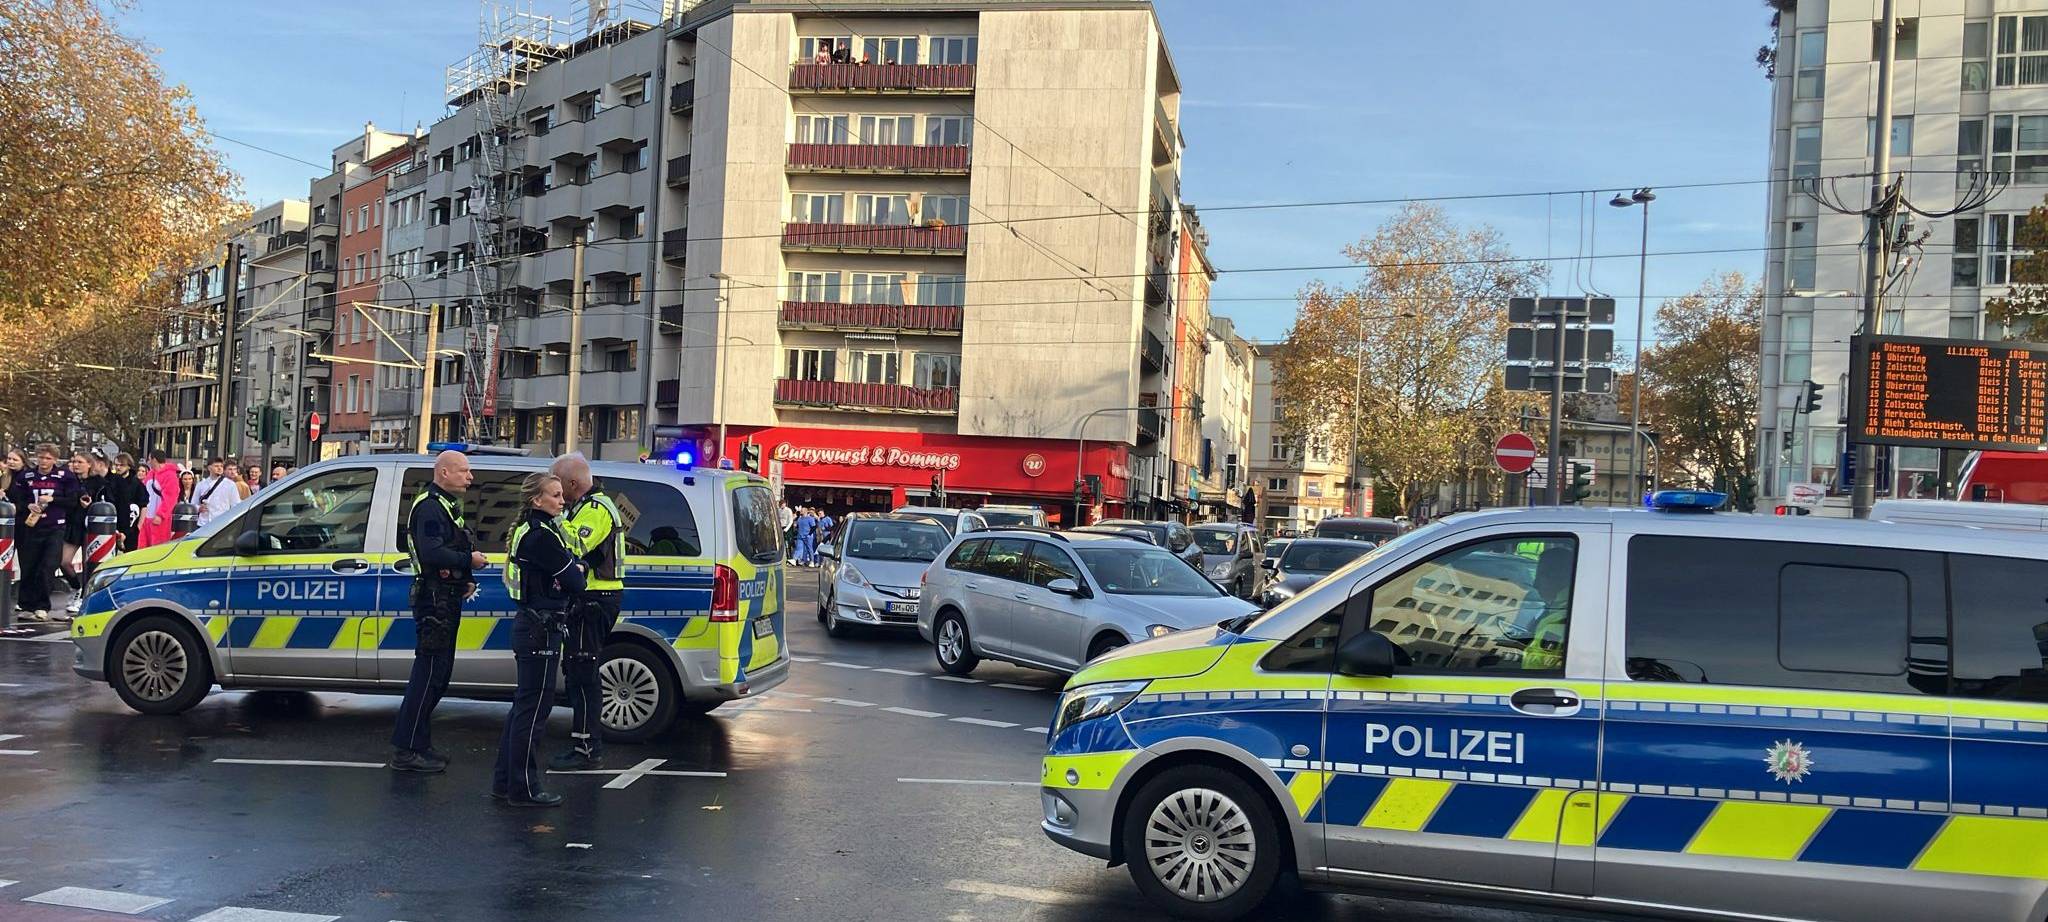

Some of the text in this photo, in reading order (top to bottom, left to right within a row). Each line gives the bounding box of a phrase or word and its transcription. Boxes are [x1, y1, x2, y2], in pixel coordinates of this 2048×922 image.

[1884, 343, 1920, 354] Dienstag
[1946, 346, 1988, 356] 11.11.2025
[1872, 352, 1880, 360] 16
[1980, 358, 2001, 366] Gleis
[2020, 360, 2046, 370] Sofort
[1872, 362, 1880, 370] 12
[1887, 362, 1926, 372] Zollstock
[1980, 368, 2000, 376] Gleis
[2018, 370, 2046, 378] Sofort
[1871, 371, 1880, 379] 12
[1886, 372, 1928, 382] Merkenich
[1980, 377, 2000, 386] Gleis
[2032, 380, 2045, 388] Min
[1870, 380, 1880, 388] 15
[1979, 386, 2000, 394] Gleis
[2031, 390, 2045, 398] Min
[1870, 390, 1879, 398] 15
[1886, 391, 1930, 400] Chorweiler
[1978, 396, 1999, 404] Gleis
[2031, 398, 2044, 406] Min
[1869, 399, 1878, 407] 12
[1885, 400, 1924, 410] Zollstock
[1978, 405, 1998, 414] Gleis
[2030, 408, 2044, 416] Min
[1884, 410, 1926, 418] Merkenich
[1978, 414, 1998, 423] Gleis
[2030, 418, 2044, 426] Min
[1884, 419, 1904, 427] Niehl
[1910, 420, 1966, 430] Sebastianstr.
[1978, 424, 1998, 432] Gleis
[1882, 428, 1938, 438] Chlodwigplatz
[1943, 431, 1974, 440] besteht
[2010, 434, 2040, 444] Gleisen
[776, 442, 960, 469] Currywurst & Pommes
[258, 580, 345, 600] POLIZEI
[740, 581, 766, 598] POLIZEI
[1365, 723, 1524, 764] POLIZEI
